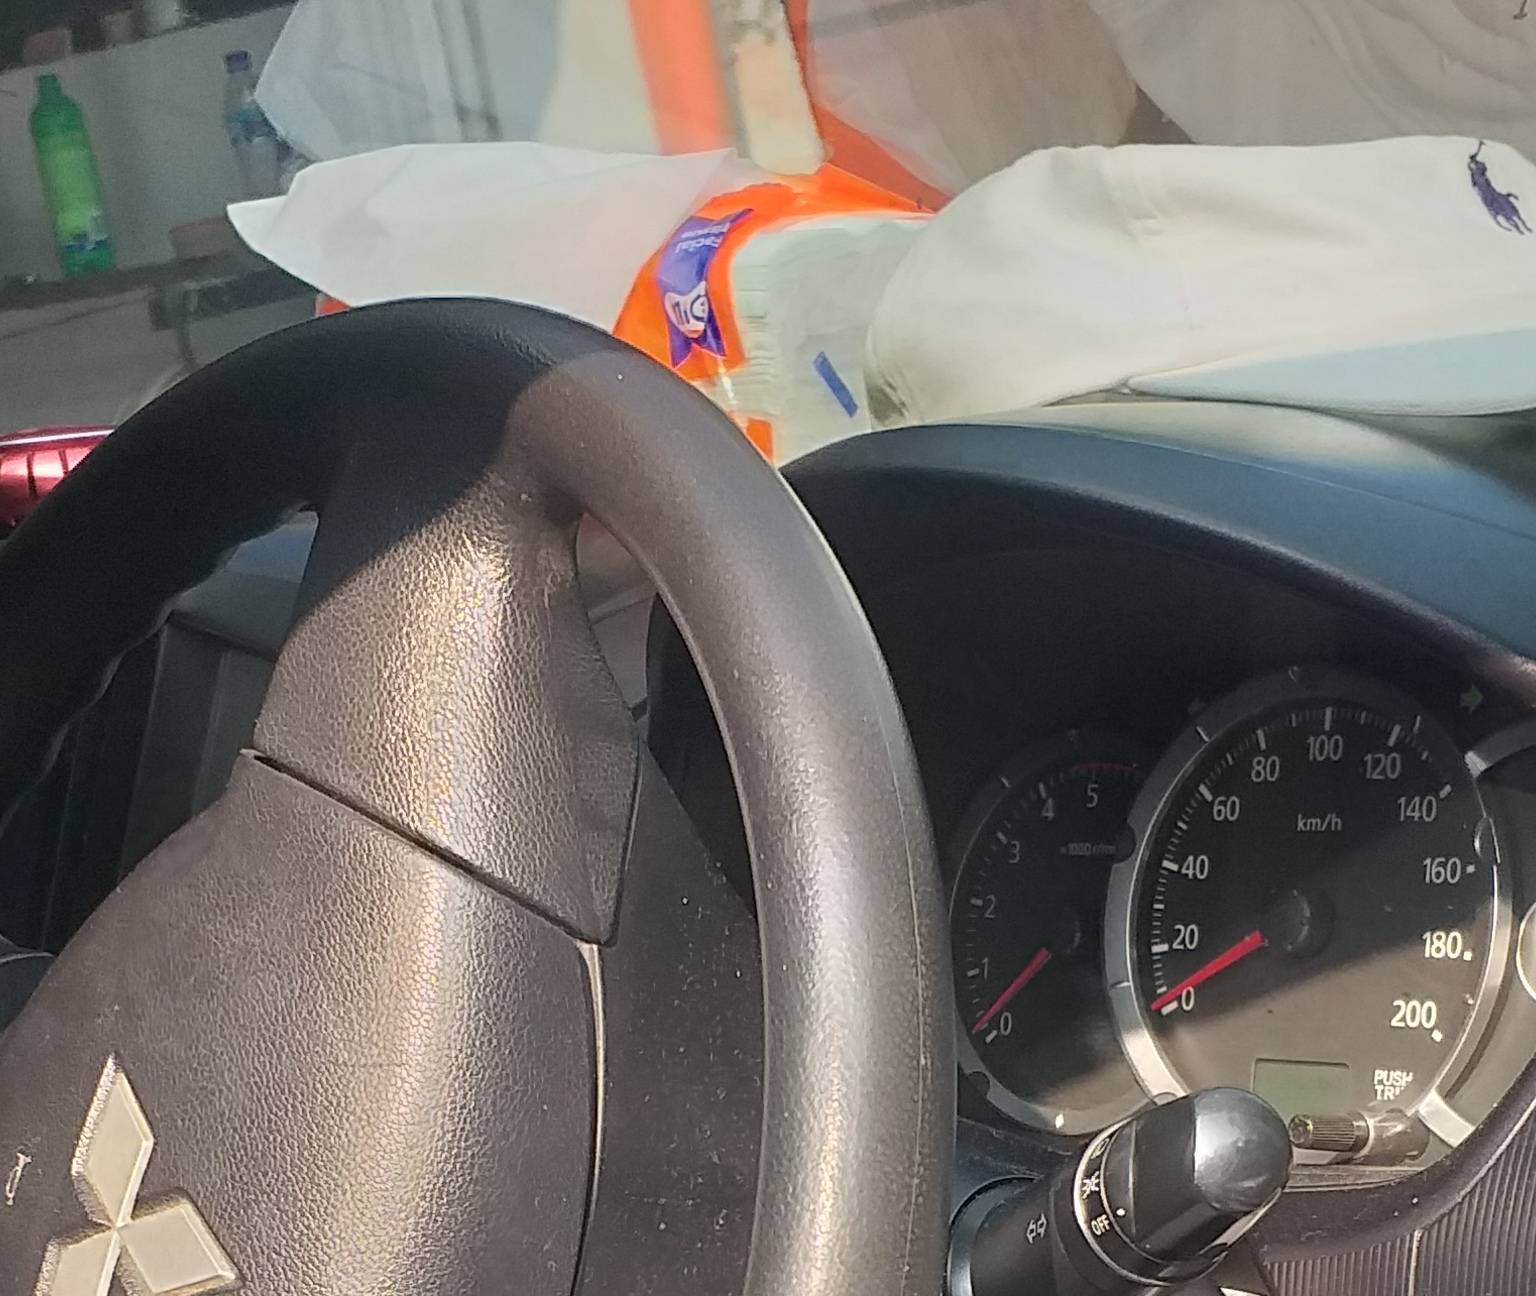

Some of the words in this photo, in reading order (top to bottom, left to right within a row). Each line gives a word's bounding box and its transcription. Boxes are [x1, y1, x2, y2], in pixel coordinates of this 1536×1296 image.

[1307, 735, 1343, 761] 100
[1251, 756, 1280, 782] 80
[1364, 753, 1401, 780] 120
[1086, 784, 1099, 807] 5
[1041, 798, 1055, 820] 4
[1213, 796, 1240, 821] 60
[1397, 796, 1437, 822] 140
[1297, 813, 1342, 832] km/h
[1008, 841, 1021, 863] 3
[1181, 855, 1209, 879] 40
[1423, 857, 1461, 883] 160
[984, 895, 997, 918] 2
[1172, 924, 1199, 950] 20
[1422, 931, 1462, 959] 180
[981, 957, 989, 981] 1
[1182, 986, 1195, 1011] 0
[1000, 1011, 1012, 1036] 0
[1390, 999, 1437, 1029] 200
[1374, 1069, 1413, 1087] PUSH
[1091, 1214, 1110, 1236] OFF
